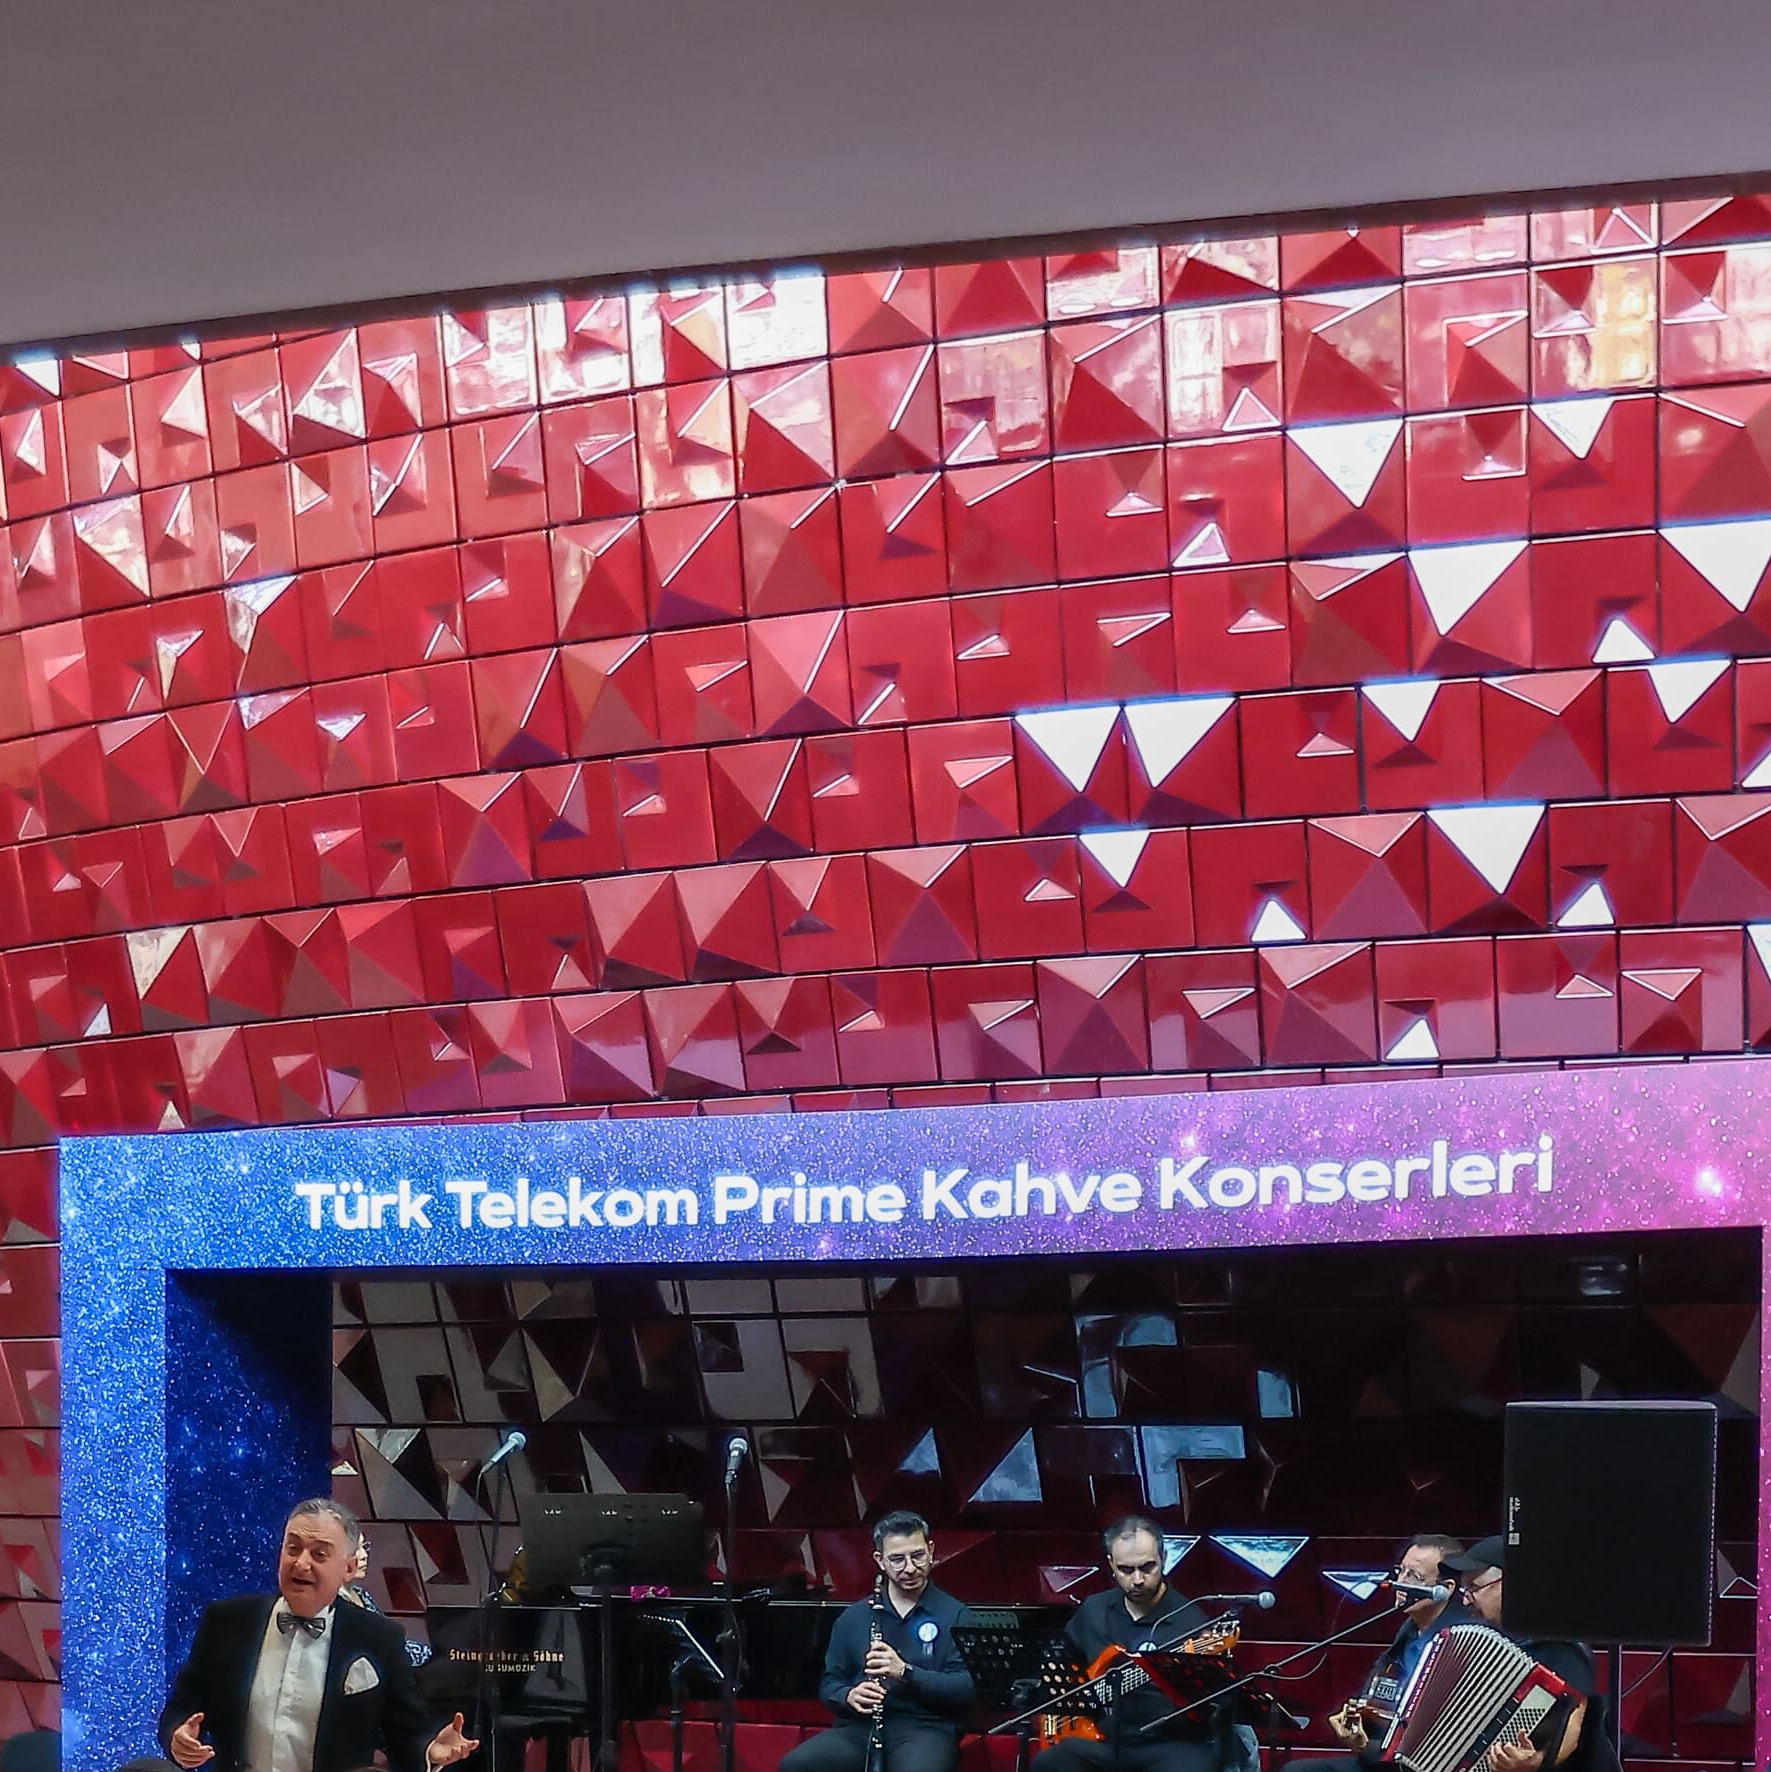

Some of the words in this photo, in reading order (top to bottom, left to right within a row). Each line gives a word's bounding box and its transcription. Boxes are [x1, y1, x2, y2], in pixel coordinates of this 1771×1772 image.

[295, 1180, 432, 1230] Türk
[445, 1177, 698, 1229] Telekom
[713, 1172, 907, 1224] Prime
[921, 1162, 1142, 1220] Kahve
[1158, 1134, 1554, 1210] Konserleri
